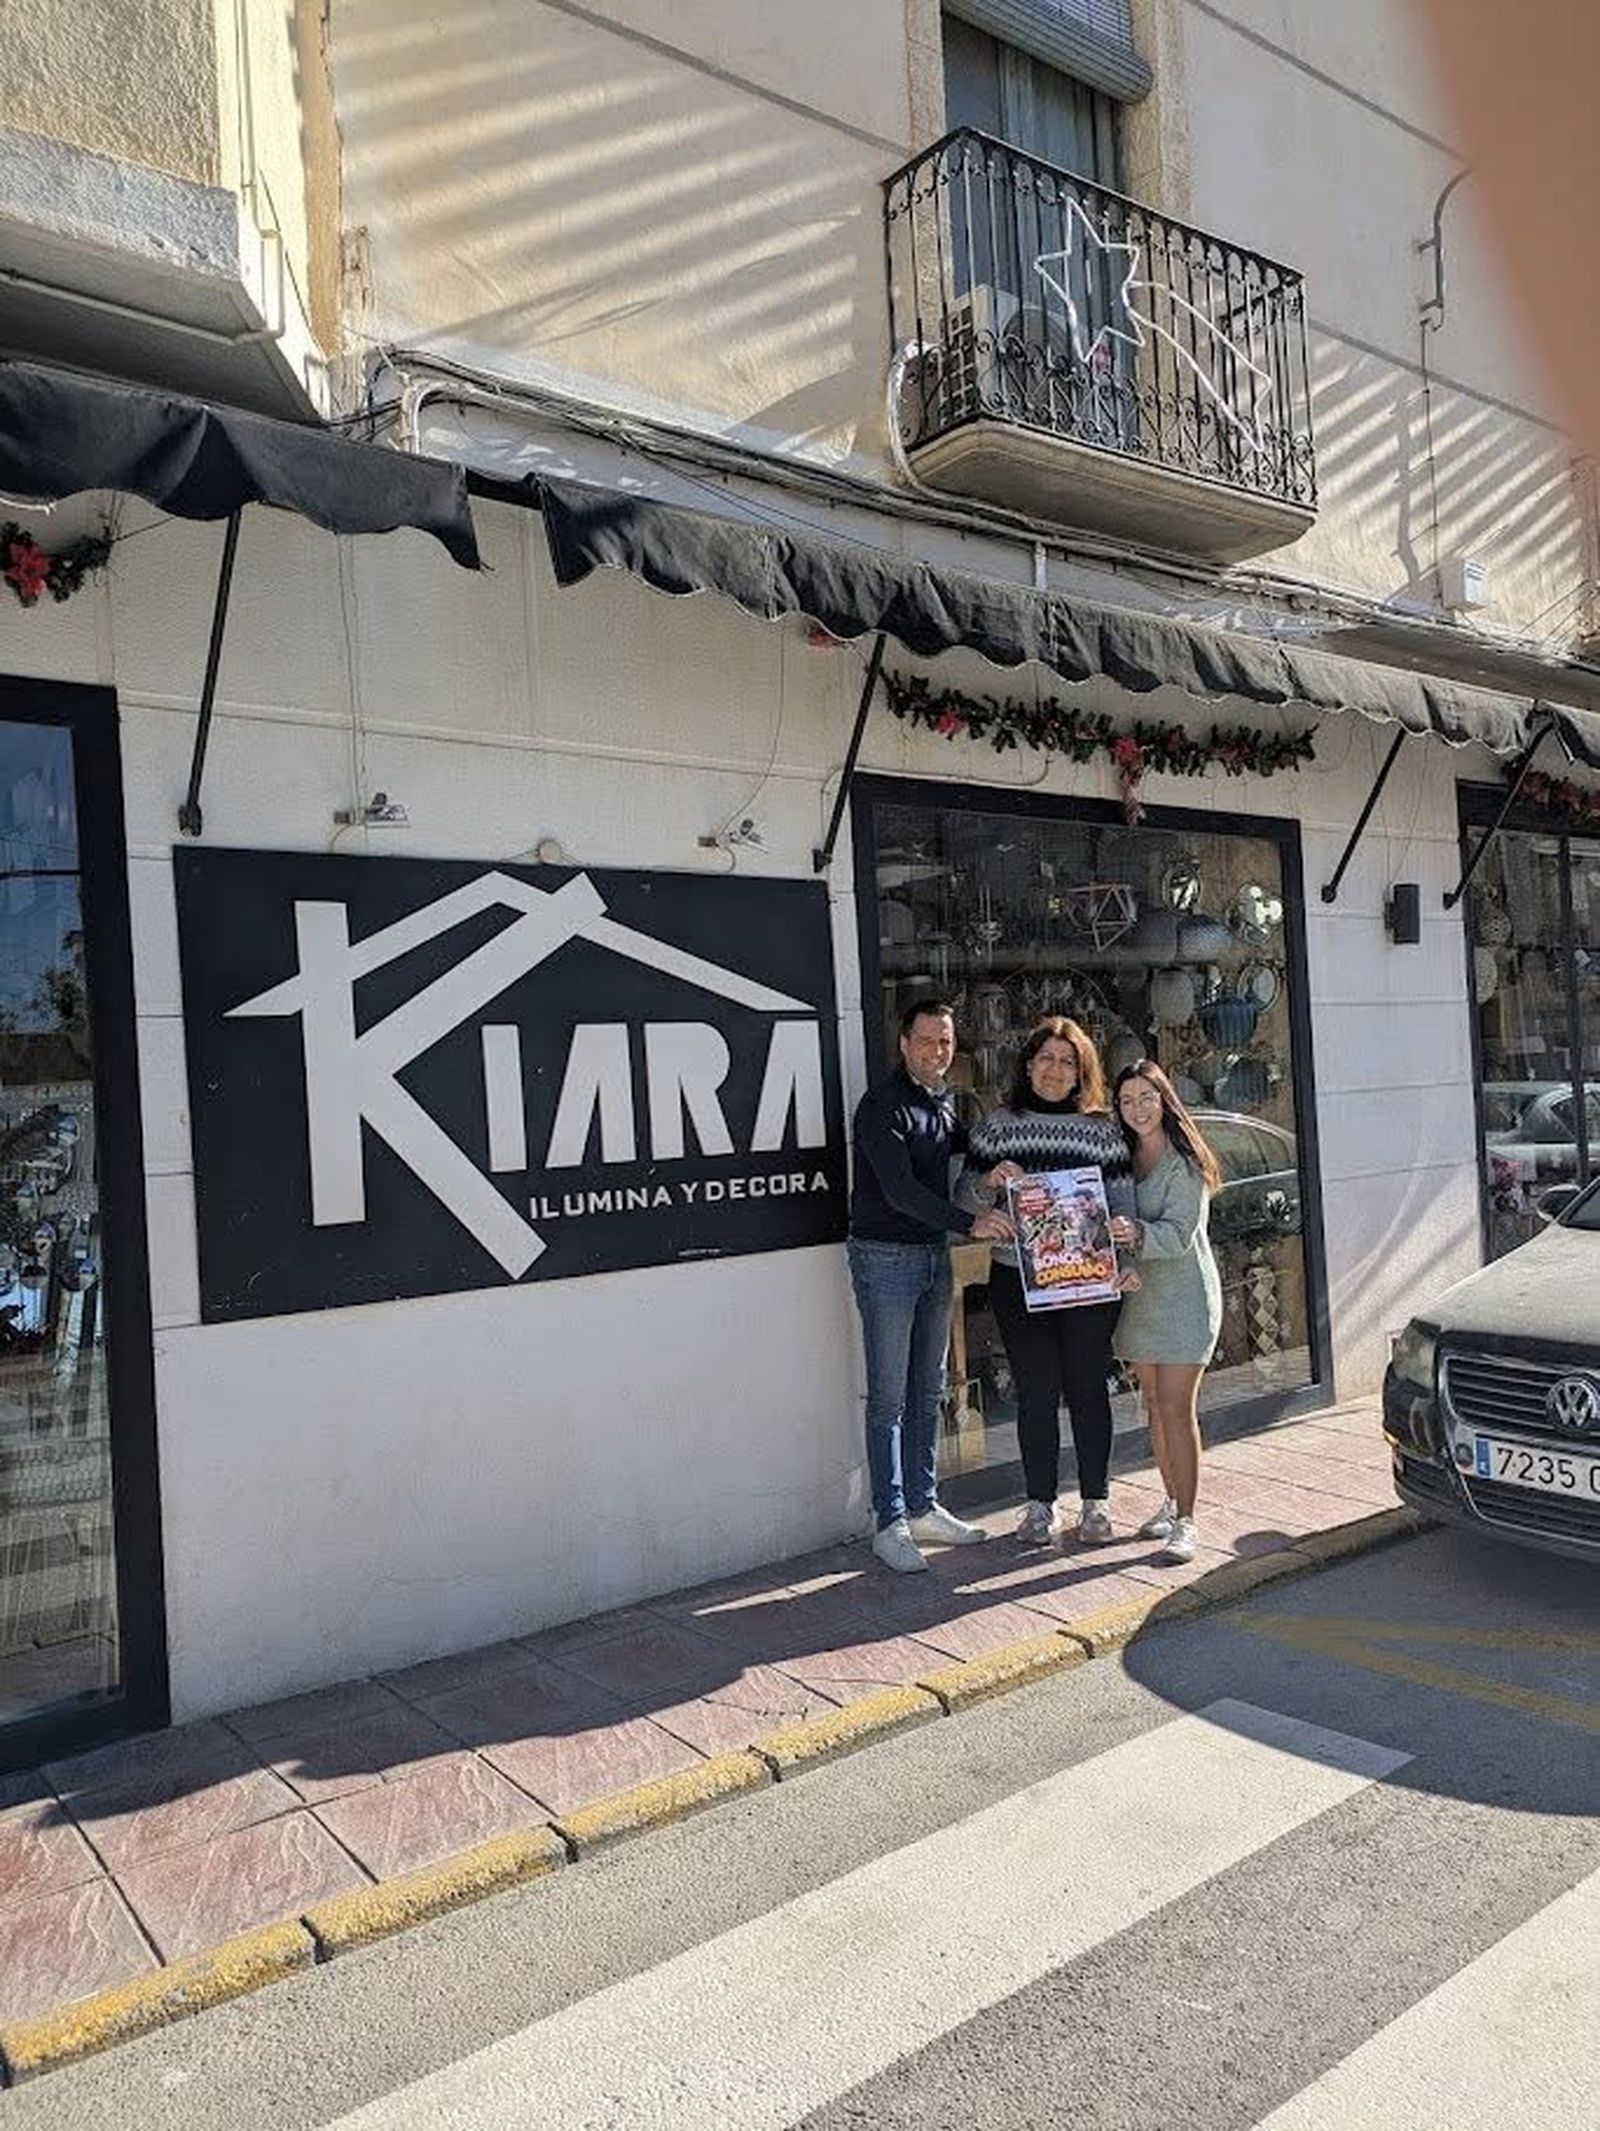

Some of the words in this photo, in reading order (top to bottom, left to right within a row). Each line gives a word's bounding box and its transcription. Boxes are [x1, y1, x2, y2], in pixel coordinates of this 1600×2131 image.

[222, 871, 827, 1281] KIARA
[529, 1186, 672, 1220] ILUMINA
[705, 1171, 829, 1201] DECORA
[1033, 1251, 1084, 1271] BONOS
[1496, 1446, 1576, 1489] 7235
